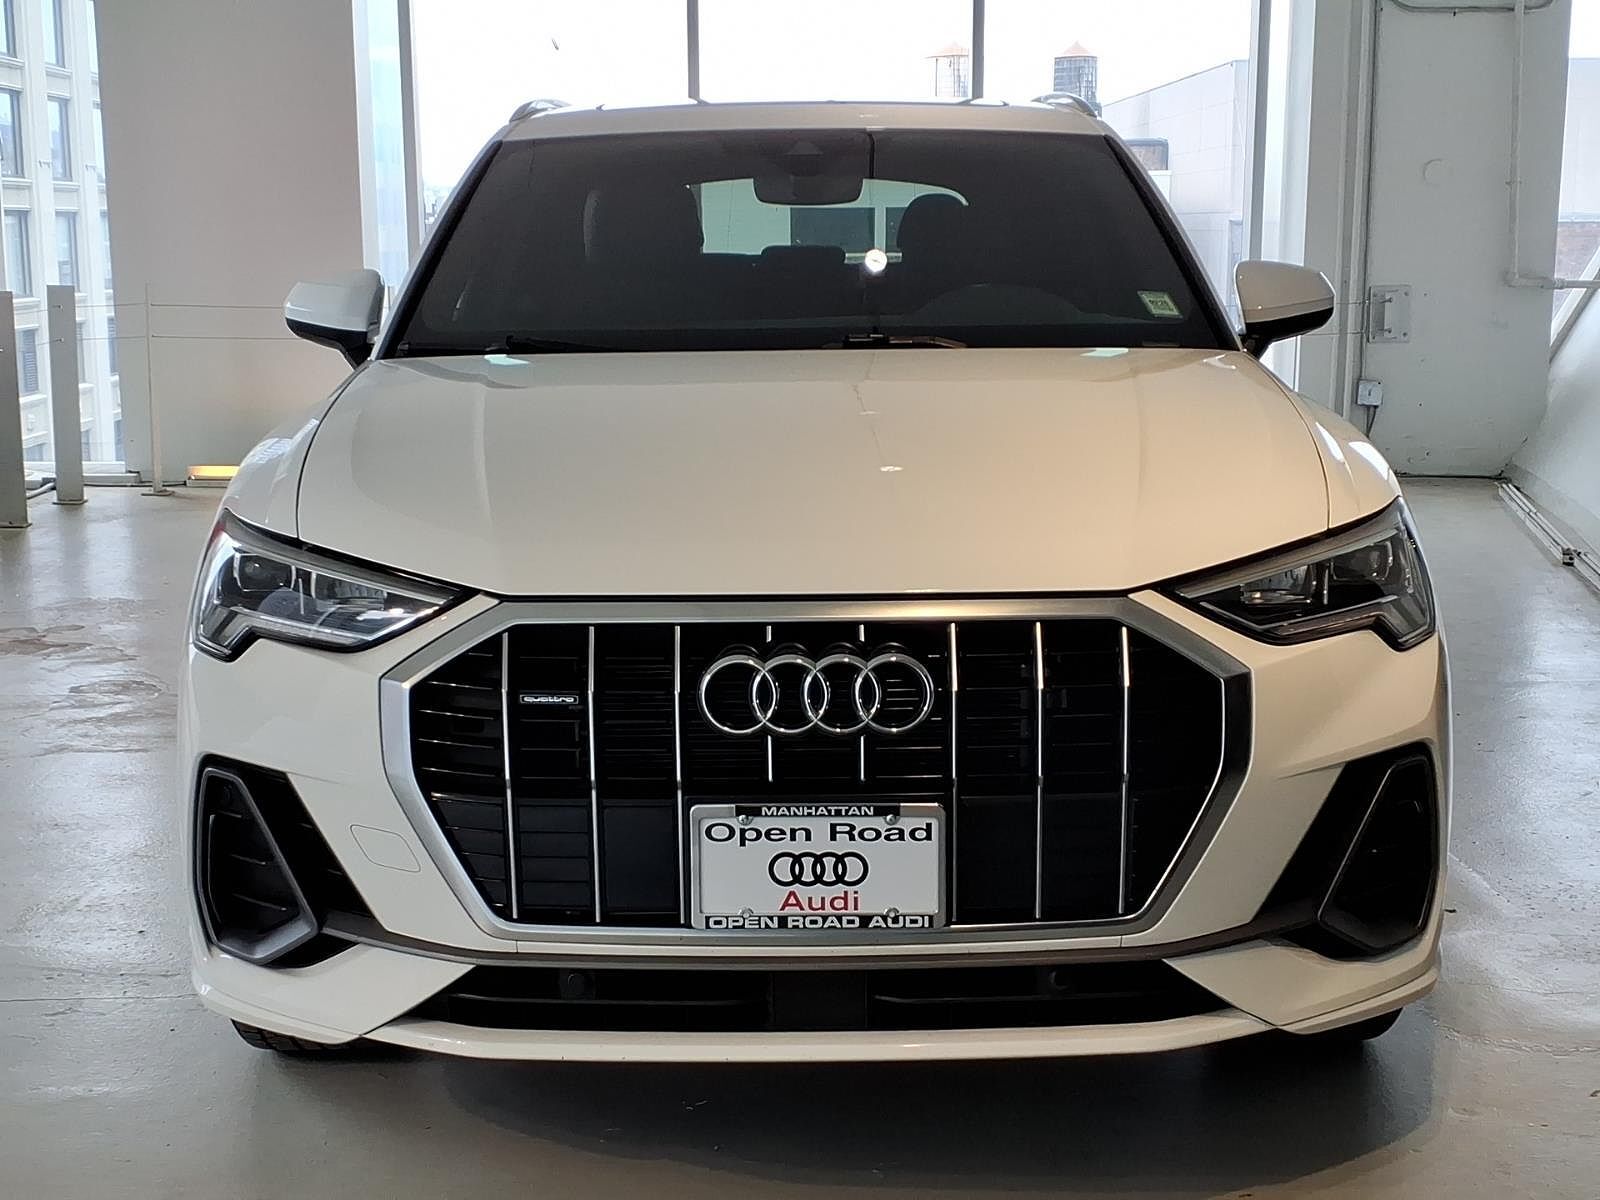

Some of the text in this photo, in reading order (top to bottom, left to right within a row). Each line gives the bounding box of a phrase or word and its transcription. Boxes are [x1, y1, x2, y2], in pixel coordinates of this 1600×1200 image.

[761, 806, 875, 817] MANHATTAN
[704, 822, 934, 848] Open Road
[779, 890, 860, 912] Audi
[708, 916, 930, 929] OPEN ROAD AUDI
